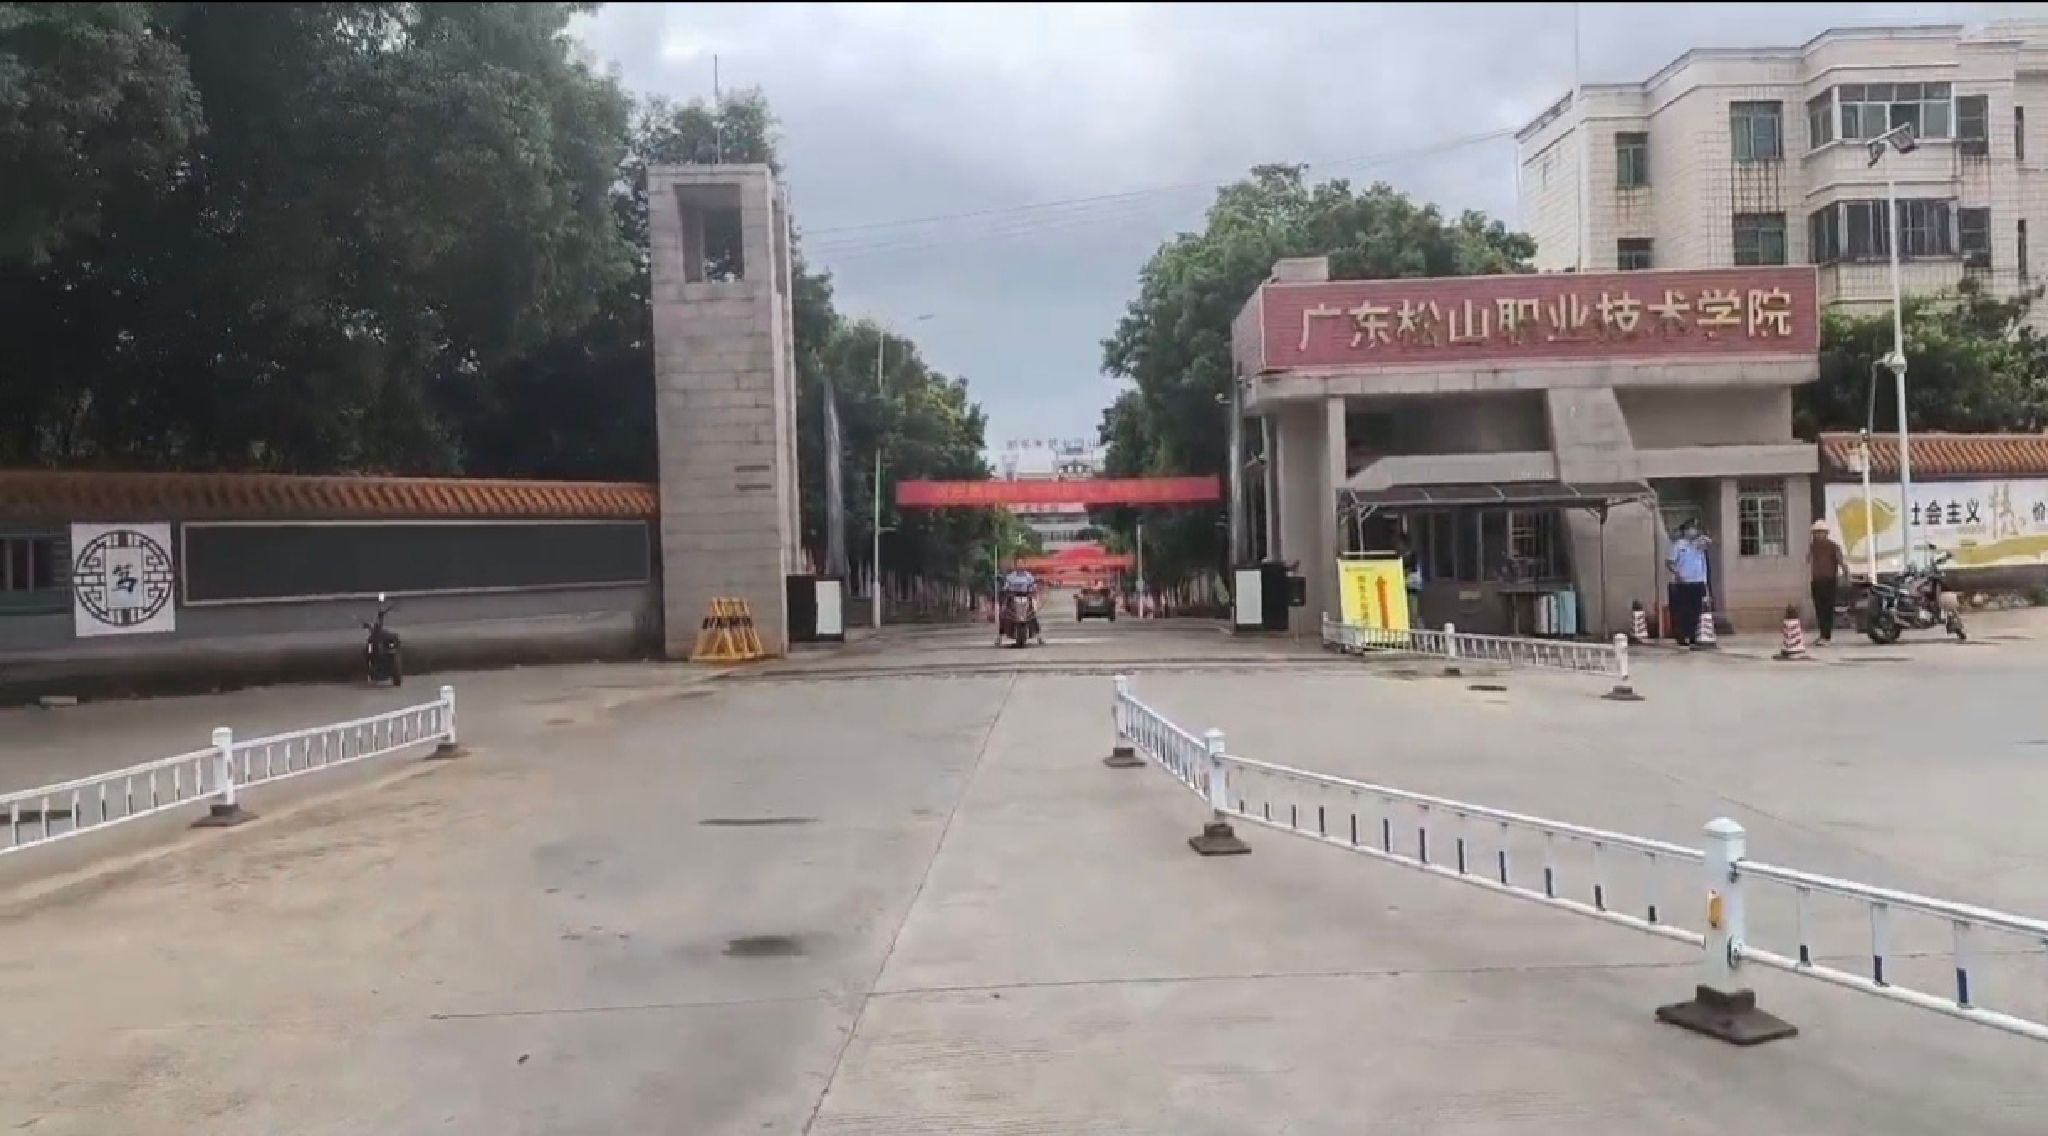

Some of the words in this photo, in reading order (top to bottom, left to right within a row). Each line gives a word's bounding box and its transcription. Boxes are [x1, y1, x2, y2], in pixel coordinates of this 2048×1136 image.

[1298, 286, 1793, 350] 广东松山职业技术学院
